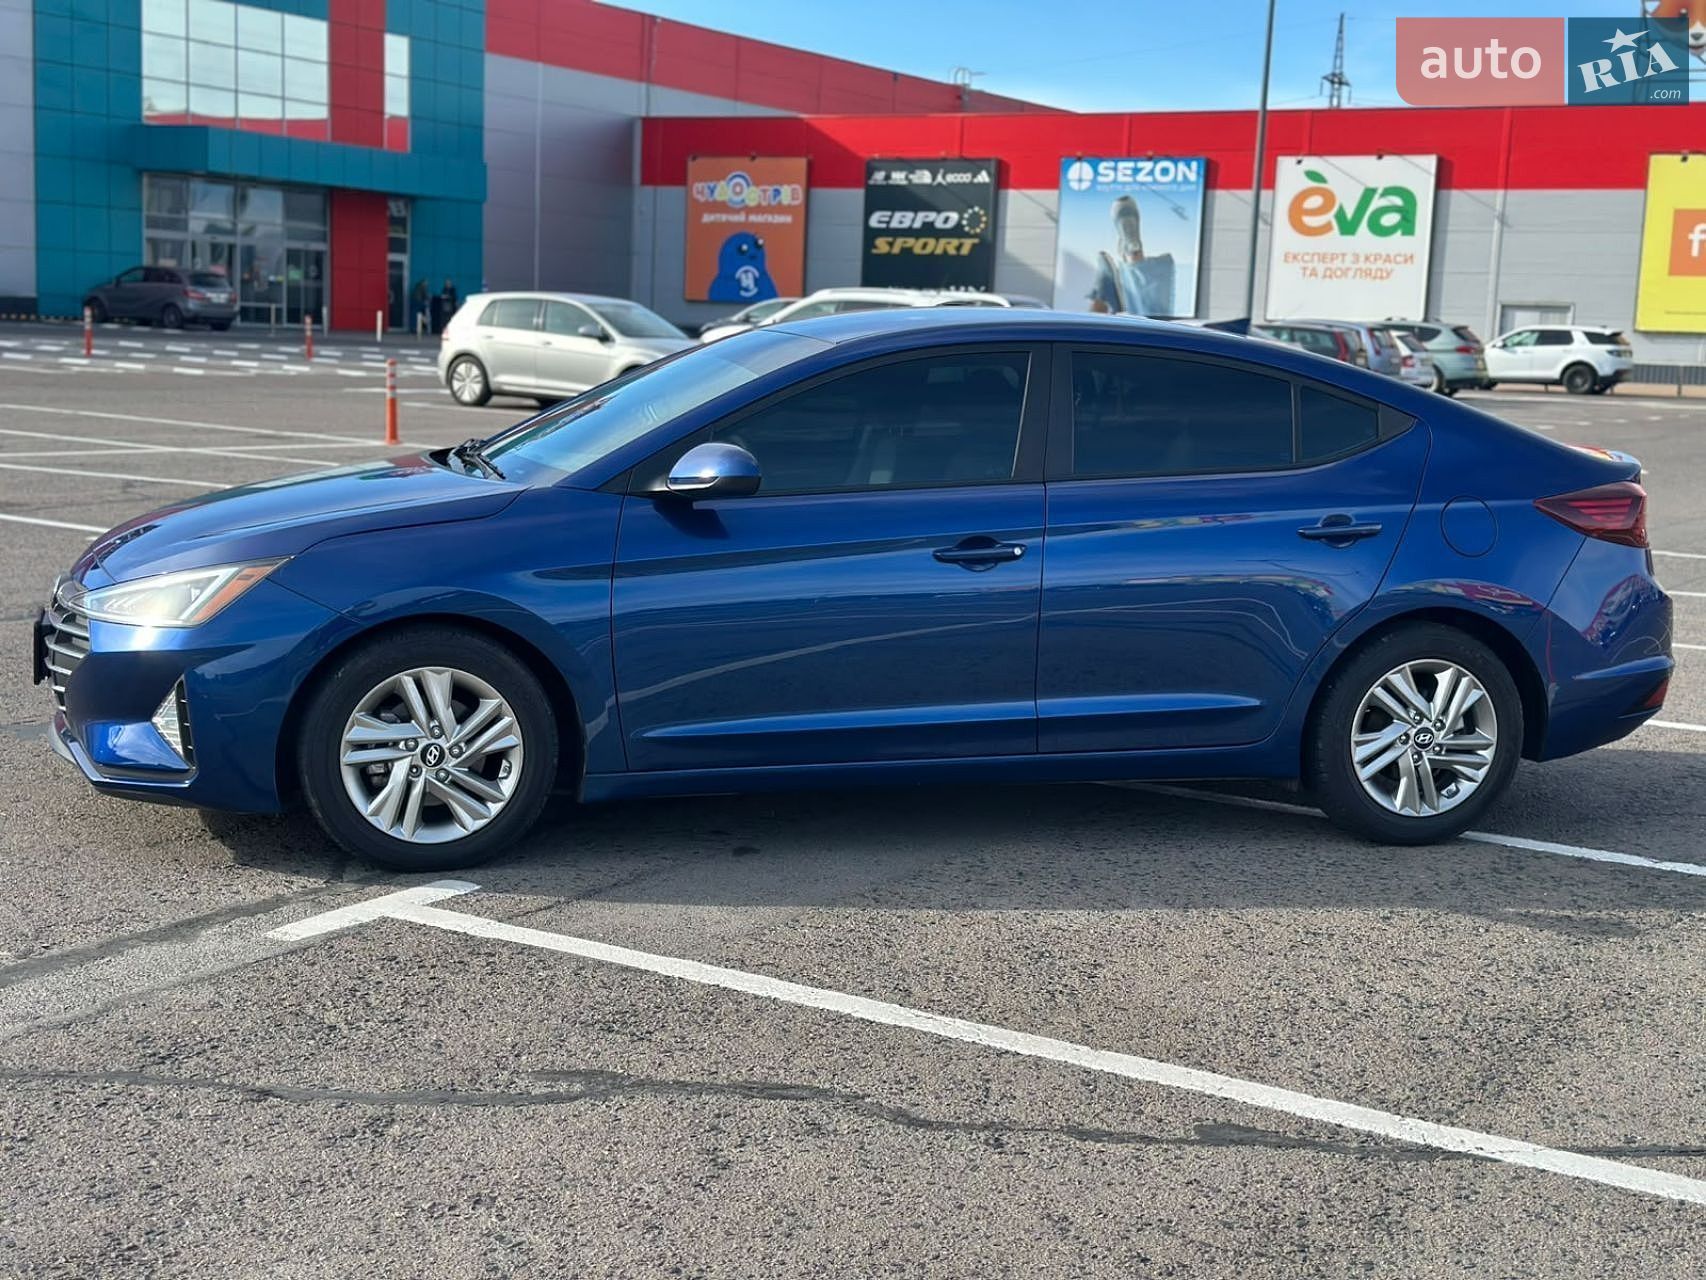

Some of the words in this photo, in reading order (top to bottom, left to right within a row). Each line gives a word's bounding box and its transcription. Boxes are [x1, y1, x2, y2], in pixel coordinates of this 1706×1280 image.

[1096, 160, 1198, 183] SEZON
[872, 237, 979, 256] SPORT
[1283, 252, 1347, 264] ЕКСПЕРТ
[1364, 253, 1415, 265] КРАСИ
[1301, 267, 1319, 279] ТА
[1322, 267, 1393, 281] ДОГЛЯДУ
